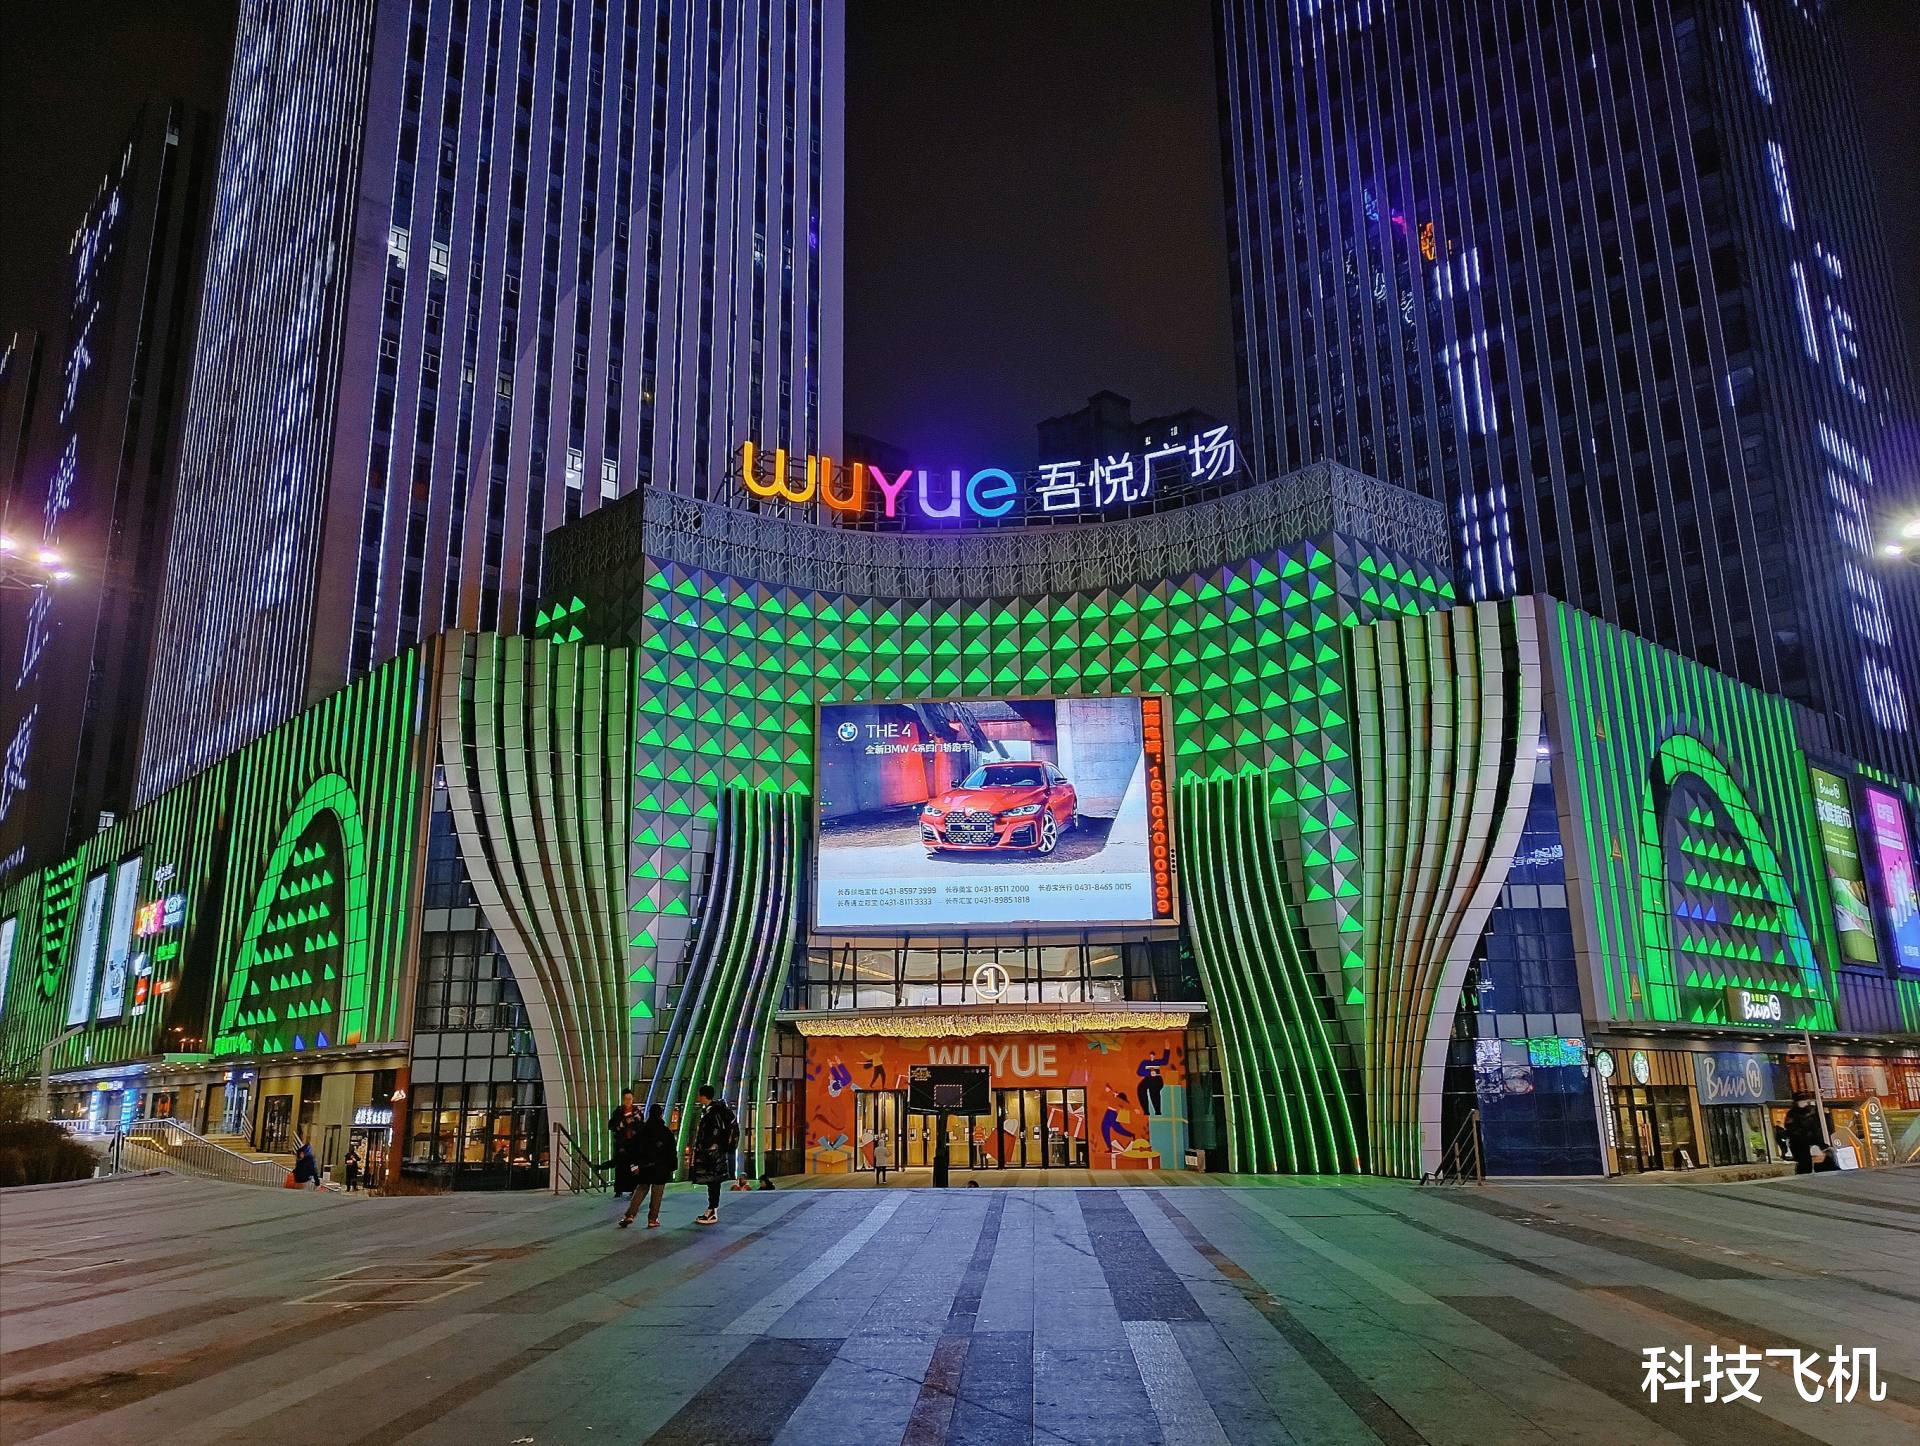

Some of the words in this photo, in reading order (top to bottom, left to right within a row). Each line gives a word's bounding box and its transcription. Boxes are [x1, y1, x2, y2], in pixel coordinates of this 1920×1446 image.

[1035, 424, 1236, 512] 吾悦广场
[865, 724, 899, 738] THE
[901, 723, 911, 738] 4
[1704, 1057, 1747, 1100] Bravo
